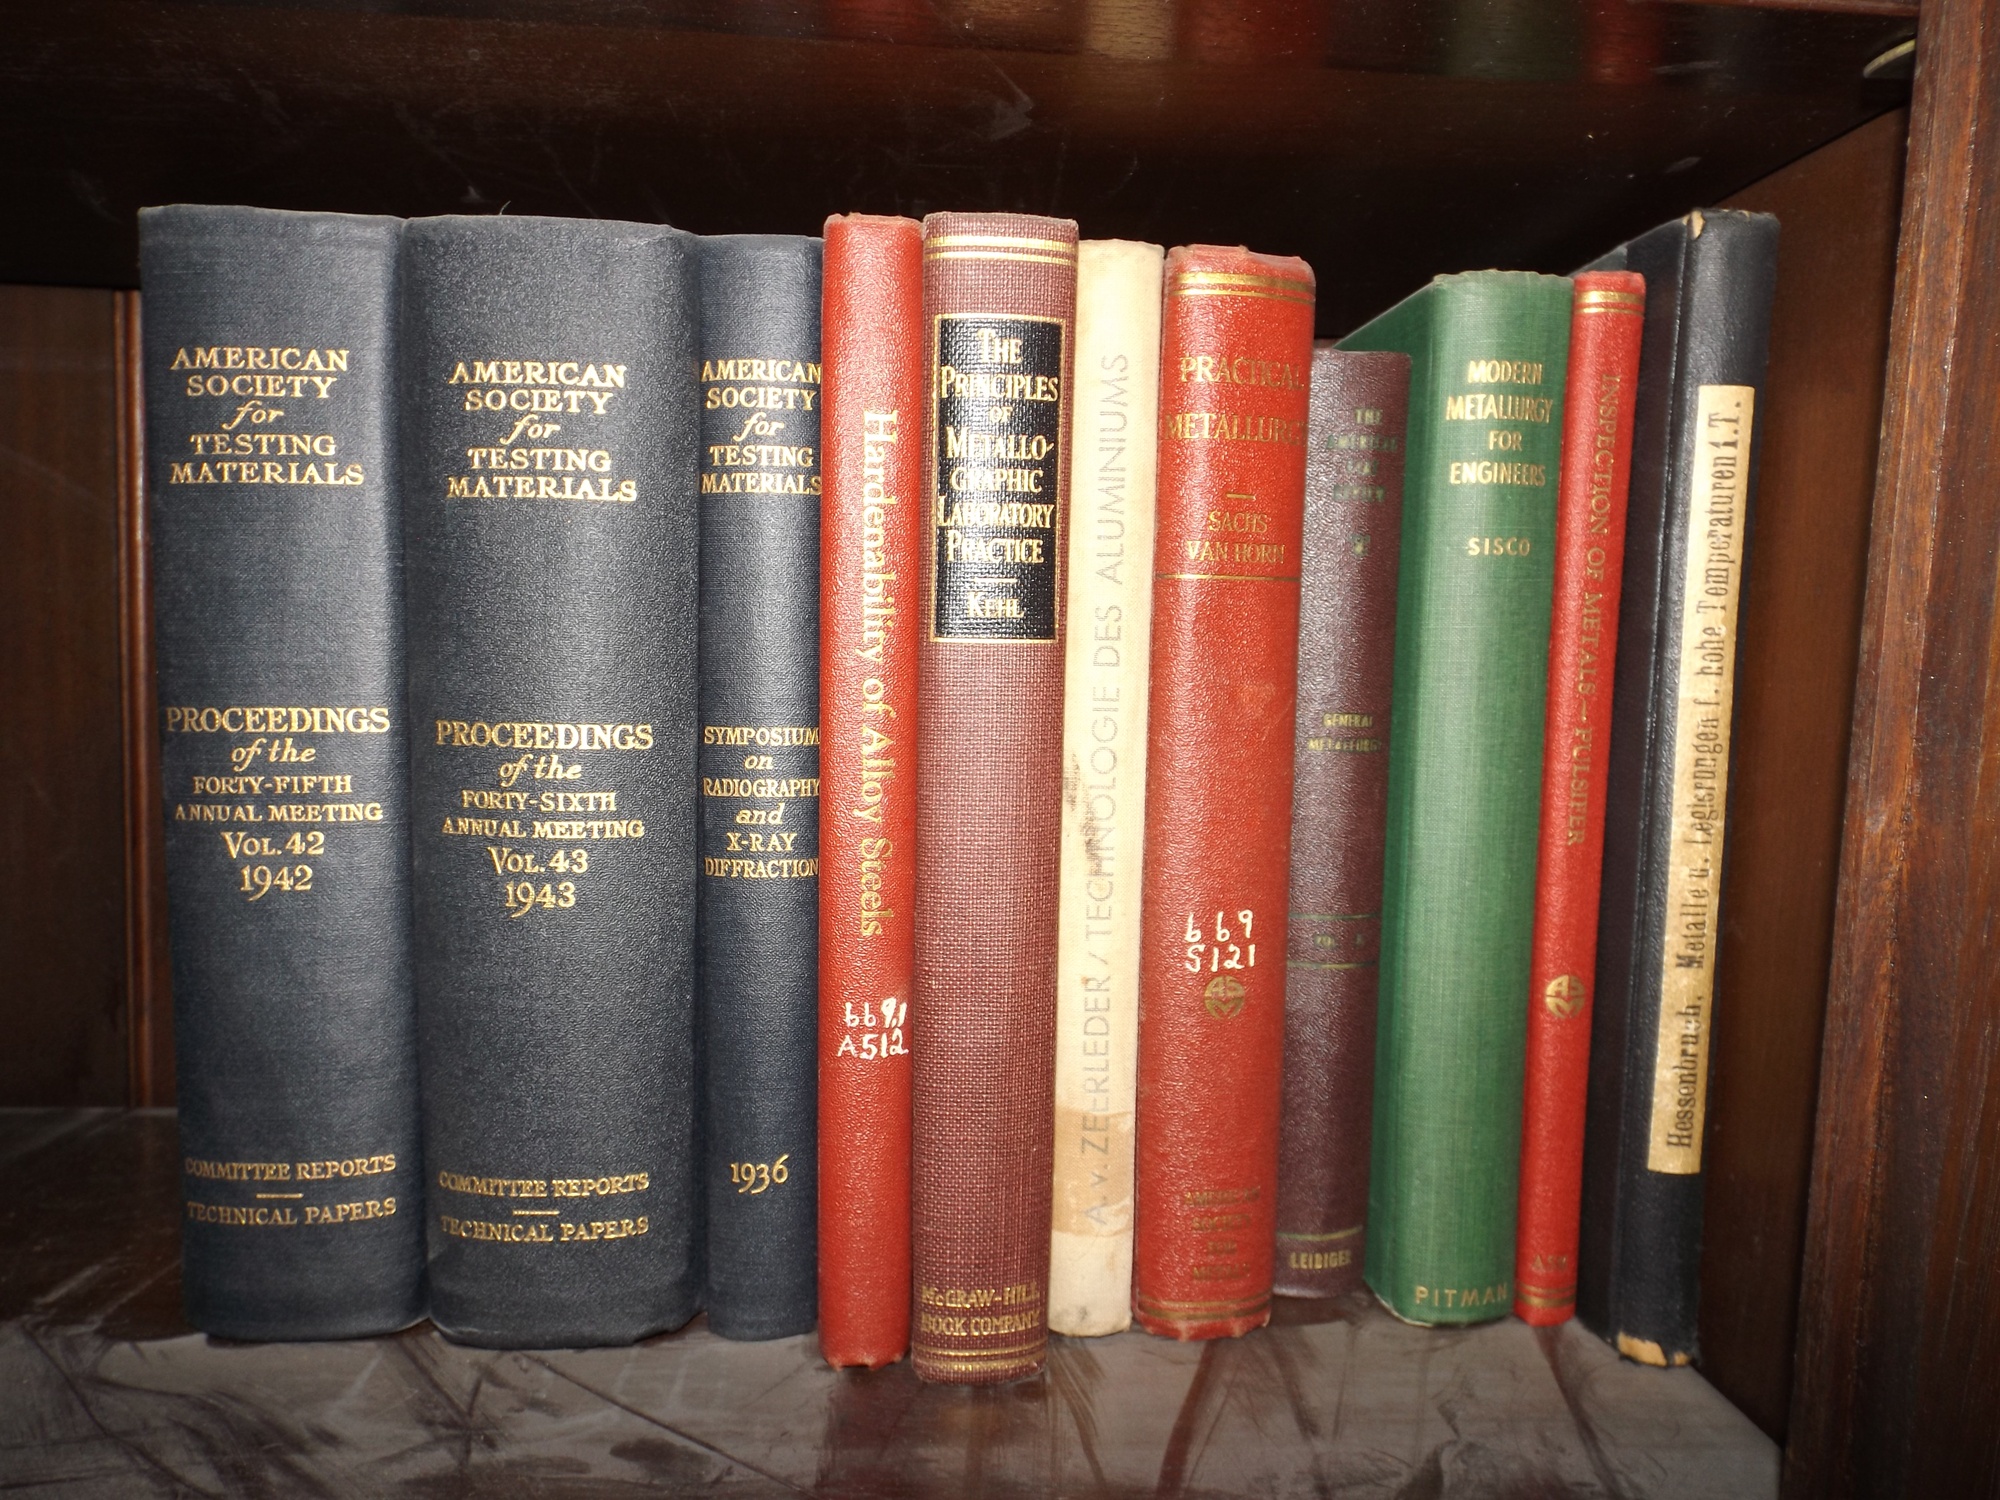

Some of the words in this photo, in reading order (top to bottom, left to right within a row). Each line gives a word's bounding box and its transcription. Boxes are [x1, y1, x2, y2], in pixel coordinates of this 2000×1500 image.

[170, 347, 350, 371] AMERICAN
[701, 359, 821, 384] AMERICAN
[1467, 360, 1543, 385] MODERN
[187, 375, 338, 398] SOCIETY
[449, 361, 627, 388] AMERICAN
[1180, 356, 1304, 390] PRACTICAL
[465, 389, 613, 414] SOCIETY
[706, 387, 817, 410] SOCIETY
[1446, 394, 1553, 423] METALLURGY
[222, 400, 284, 430] for
[732, 411, 785, 442] for
[500, 413, 560, 445] for
[1489, 430, 1523, 451] FOR
[190, 433, 337, 456] TESTING
[709, 445, 814, 467] TESTING
[1590, 373, 1621, 536] INSPECTION
[169, 461, 365, 485] MATERIALS
[468, 448, 612, 472] TESTING
[1096, 354, 1129, 586] ALUMINIUMS
[1450, 461, 1546, 486] ENGINEERS
[447, 476, 638, 502] MATERIALS
[701, 472, 821, 495] MATERIALS
[950, 467, 1044, 494] GRAPHIC
[938, 495, 1055, 529] LABORATORY
[1209, 510, 1268, 533] SACHS
[855, 409, 899, 662] Hardenability
[947, 530, 1045, 564] PRACTICE
[1467, 536, 1531, 556] SISCO
[1187, 540, 1229, 562] VAN
[1235, 542, 1285, 564] HORN
[1585, 547, 1606, 581] OF
[1093, 604, 1123, 668] DES
[1577, 592, 1603, 696] METALS
[862, 677, 897, 718] of
[166, 707, 391, 733] PROCEEDINGS
[1675, 888, 1710, 969] Metalle
[1696, 456, 1738, 615] Temperaturen
[435, 719, 654, 750] PROCEEDINGS
[704, 726, 820, 746] SYMPOSIUM
[231, 737, 267, 772] of
[268, 738, 316, 762] the
[744, 755, 774, 770] on
[193, 775, 353, 794] FORTY-FIFTH
[499, 754, 533, 788] of
[534, 754, 582, 779] the
[853, 725, 897, 824] Alloy
[702, 777, 820, 797] RADIOGRAPHY
[1567, 727, 1593, 846] PULSIFER
[174, 804, 262, 822] ANNUAL
[268, 803, 384, 822] MEETING
[461, 789, 617, 812] FORTY-SIXTH
[735, 802, 786, 825] and
[1084, 686, 1120, 942] TECHNOLOGIE
[442, 817, 527, 838] ANNUAL
[532, 819, 645, 839] MEETING
[726, 832, 797, 851] X-RAY
[285, 831, 325, 855] 42
[550, 849, 589, 873] 43
[704, 857, 819, 878] DIFFRACTION
[240, 865, 313, 901] 1942
[860, 837, 894, 937] Steels
[505, 880, 576, 919] 1943
[837, 1027, 909, 1060] A512
[1081, 976, 1111, 1155] ZEERLEDER
[185, 1157, 291, 1181] COMMITTEE
[296, 1154, 397, 1180] REPORTS
[730, 1153, 790, 1195] 1936
[438, 1170, 548, 1198] COMMITTEE
[551, 1171, 650, 1198] REPORTS
[187, 1201, 298, 1225] TECHNICAL
[304, 1197, 397, 1224] PAPERS
[440, 1216, 554, 1242] TECHNICAL
[560, 1216, 650, 1242] PAPERS
[1414, 1283, 1508, 1308] PITMAN
[920, 1312, 967, 1336] BOOK
[969, 1309, 1040, 1336] COMPANY
